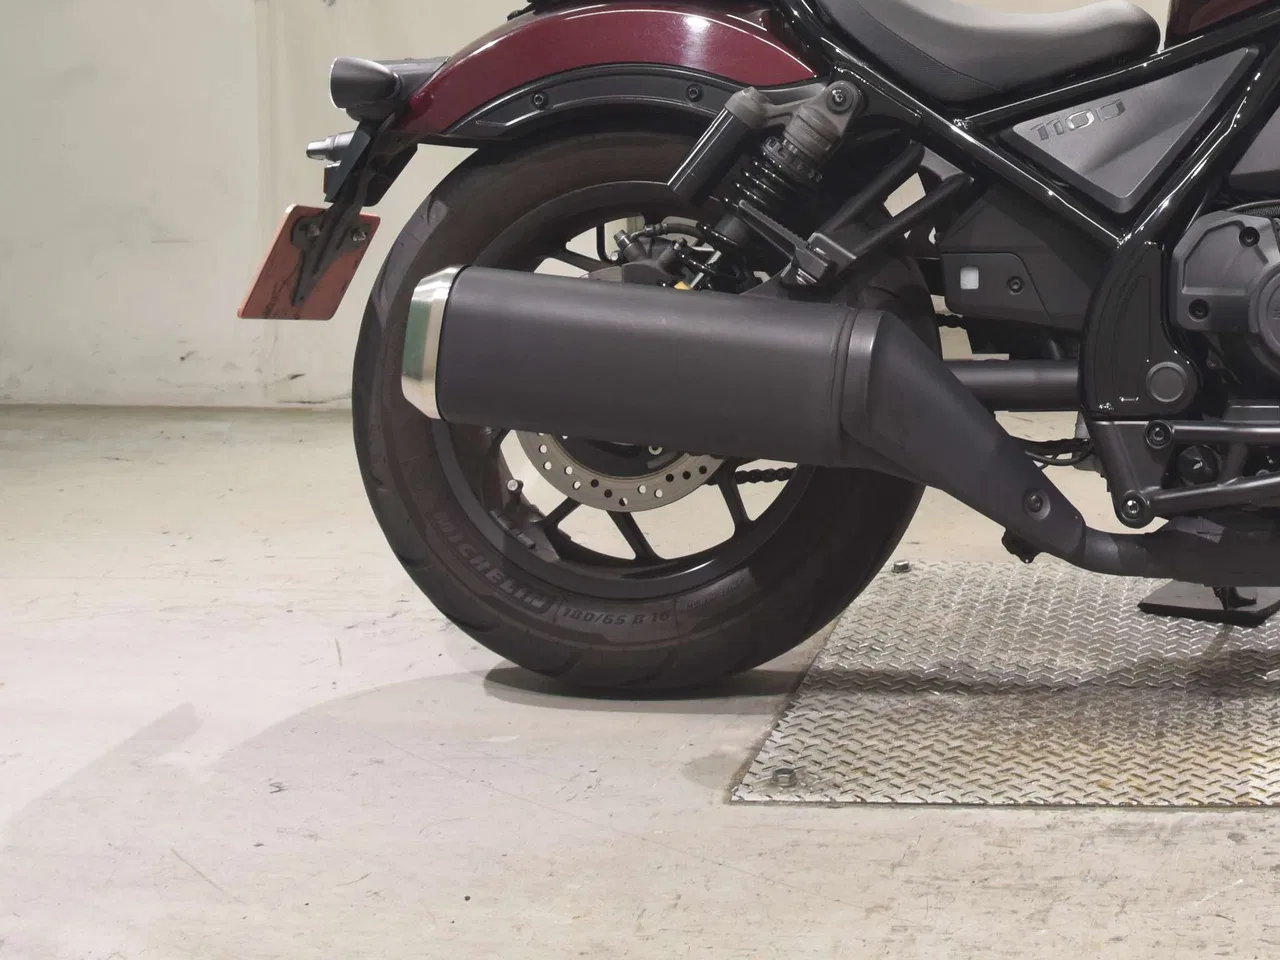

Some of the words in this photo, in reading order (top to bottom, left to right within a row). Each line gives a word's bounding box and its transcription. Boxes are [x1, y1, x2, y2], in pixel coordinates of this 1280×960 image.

[1030, 98, 1126, 141] 1100
[435, 512, 546, 608] MICHELIN
[562, 607, 626, 625] 180/65
